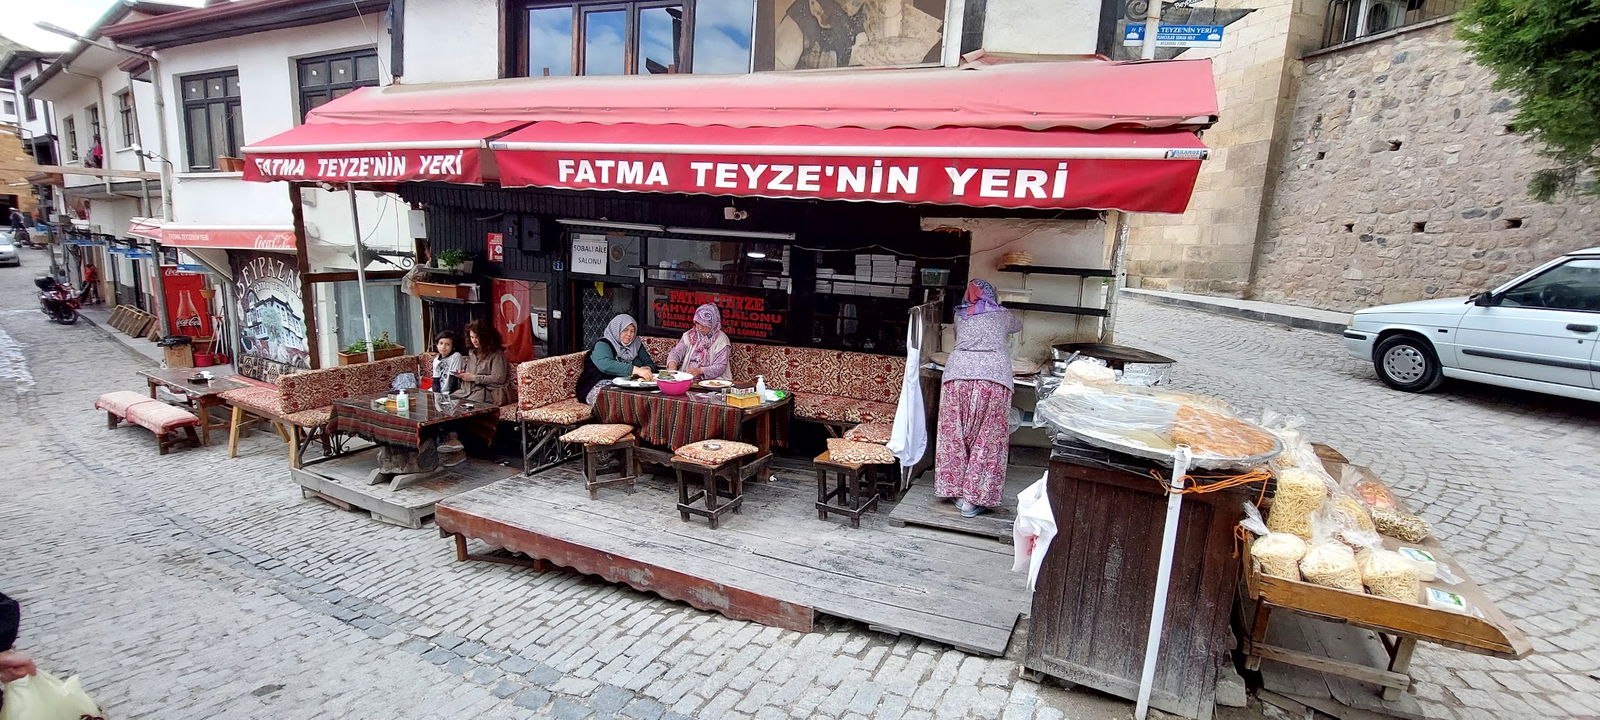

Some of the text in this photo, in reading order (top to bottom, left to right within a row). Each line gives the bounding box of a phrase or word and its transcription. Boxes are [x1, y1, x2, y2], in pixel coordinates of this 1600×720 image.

[255, 150, 464, 177] FATMA TEYZE'NİN YERİ
[557, 158, 1068, 199] FATMA TEYZE'NİN YERİ
[573, 244, 593, 253] SOBALI
[578, 257, 602, 265] SALONU
[235, 256, 302, 300] BEYPAZA
[721, 309, 782, 323] SALONU
[740, 320, 773, 331] YUMURTA
